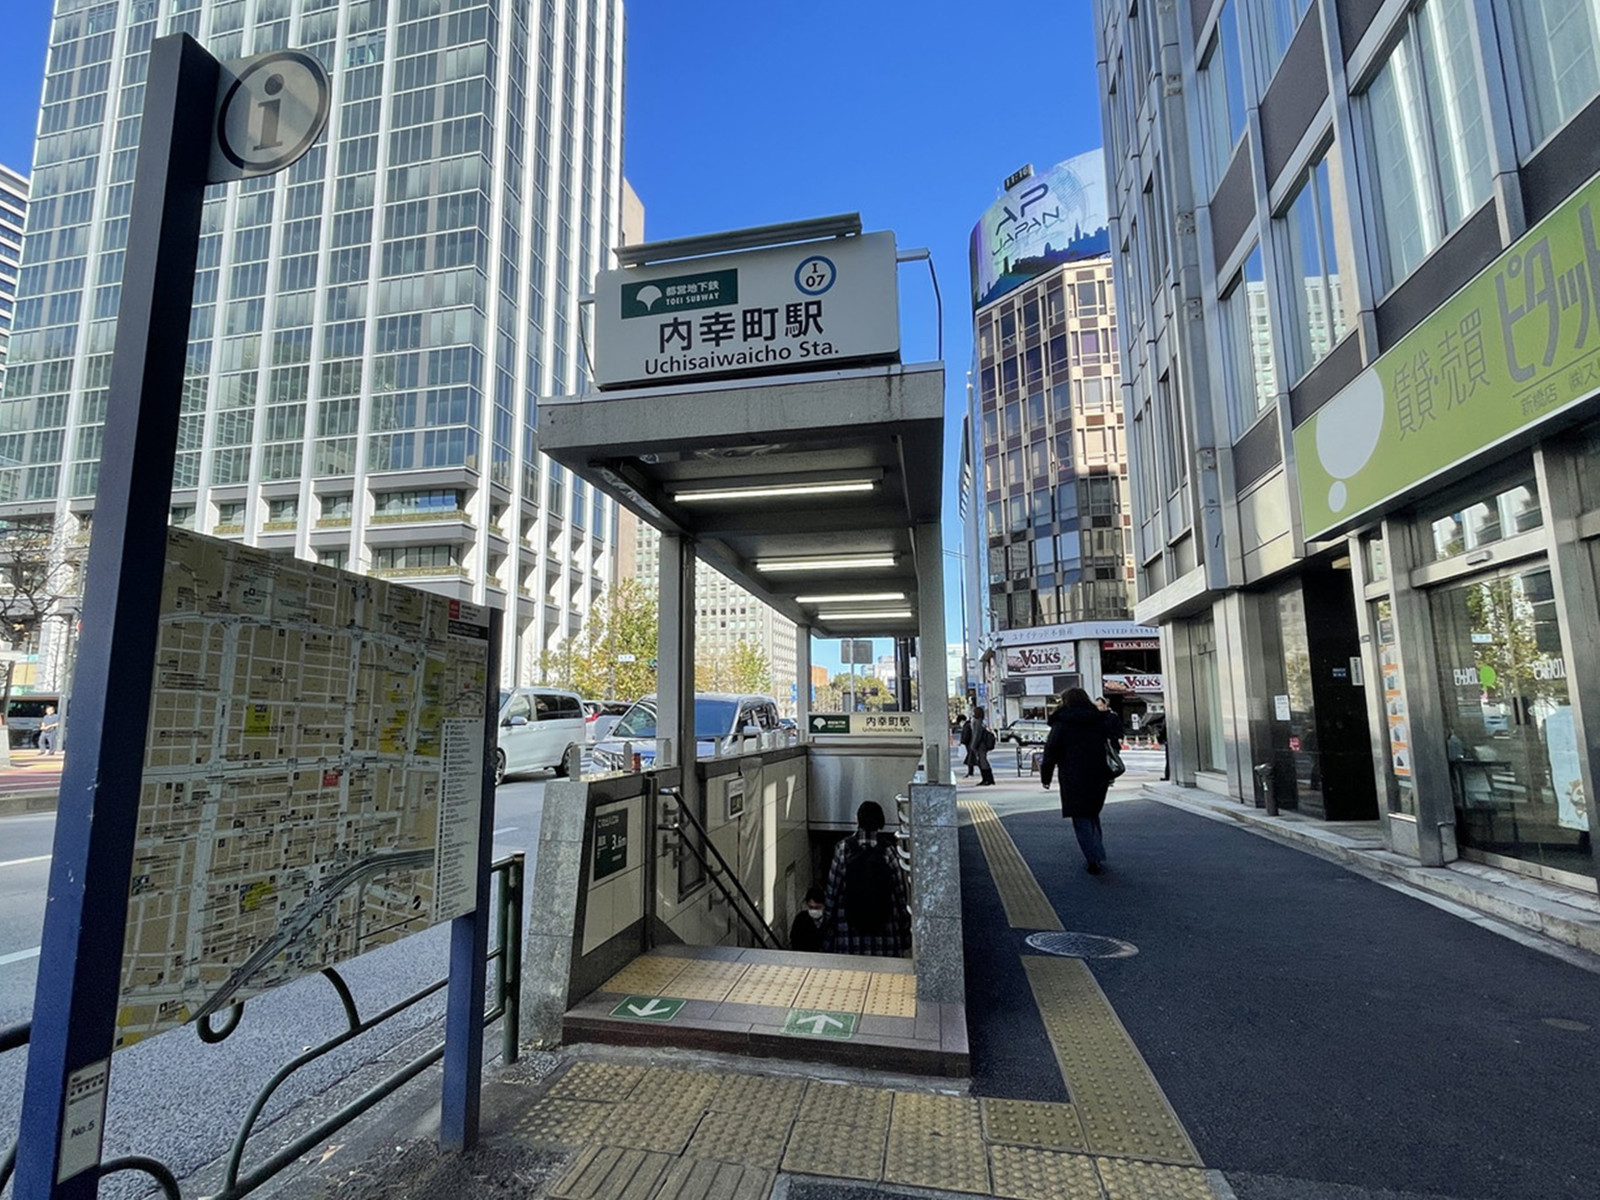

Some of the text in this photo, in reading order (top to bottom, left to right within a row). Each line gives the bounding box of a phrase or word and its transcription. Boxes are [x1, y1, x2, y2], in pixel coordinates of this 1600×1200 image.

[666, 280, 719, 296] 都営地下鉄
[806, 274, 826, 288] 07
[666, 293, 720, 306] TOEI SUBWAY
[659, 299, 824, 354] 内幸町駅
[645, 341, 839, 376] Uchisaiwaicho Sta.
[1019, 650, 1061, 668] VOLKS
[1124, 676, 1160, 689] VOLKS
[866, 716, 910, 726] 内幸町駅
[70, 1119, 95, 1139] No.5
